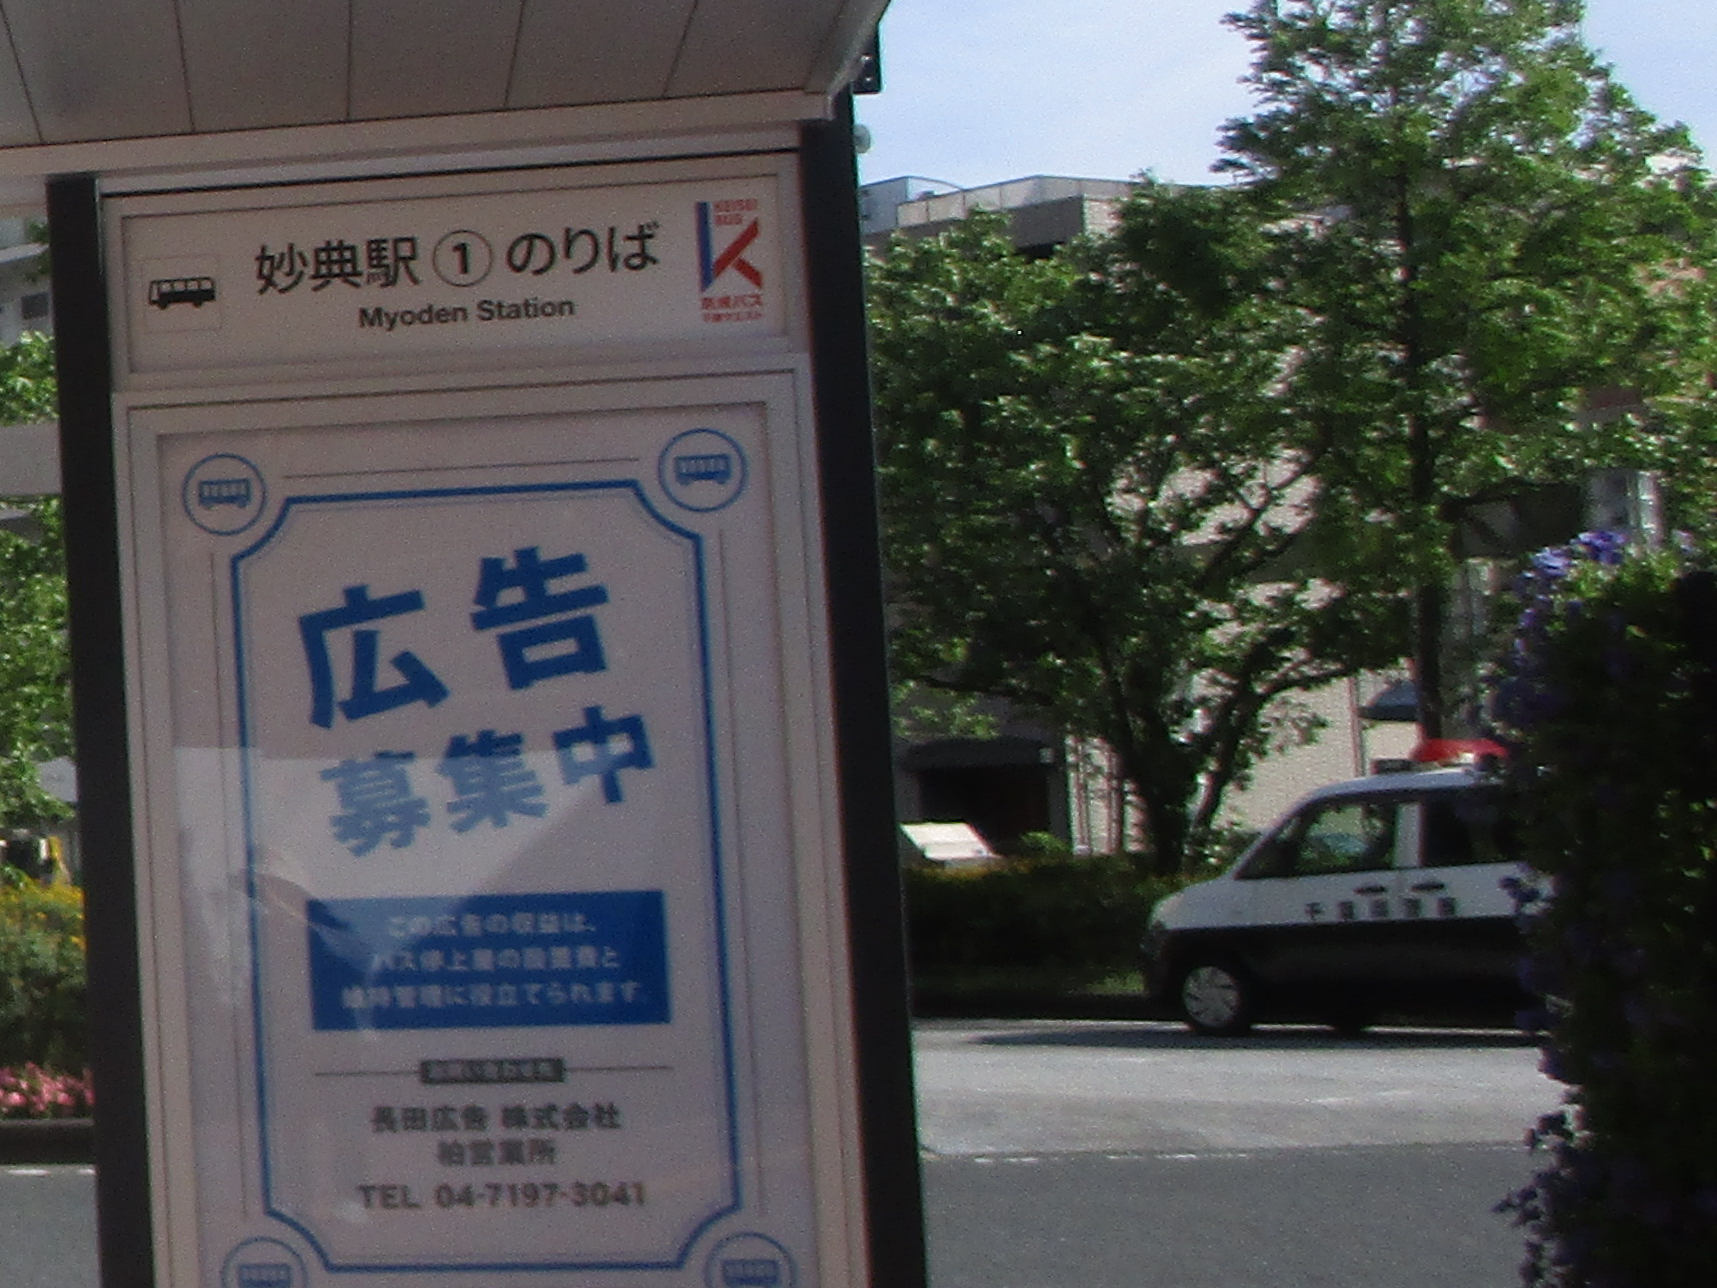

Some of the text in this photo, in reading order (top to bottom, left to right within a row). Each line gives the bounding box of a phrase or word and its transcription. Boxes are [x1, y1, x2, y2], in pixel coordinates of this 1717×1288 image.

[359, 297, 576, 332] Myoden Station
[299, 546, 611, 730] 広告
[320, 705, 657, 858] 募集中
[356, 1183, 421, 1209] TEL
